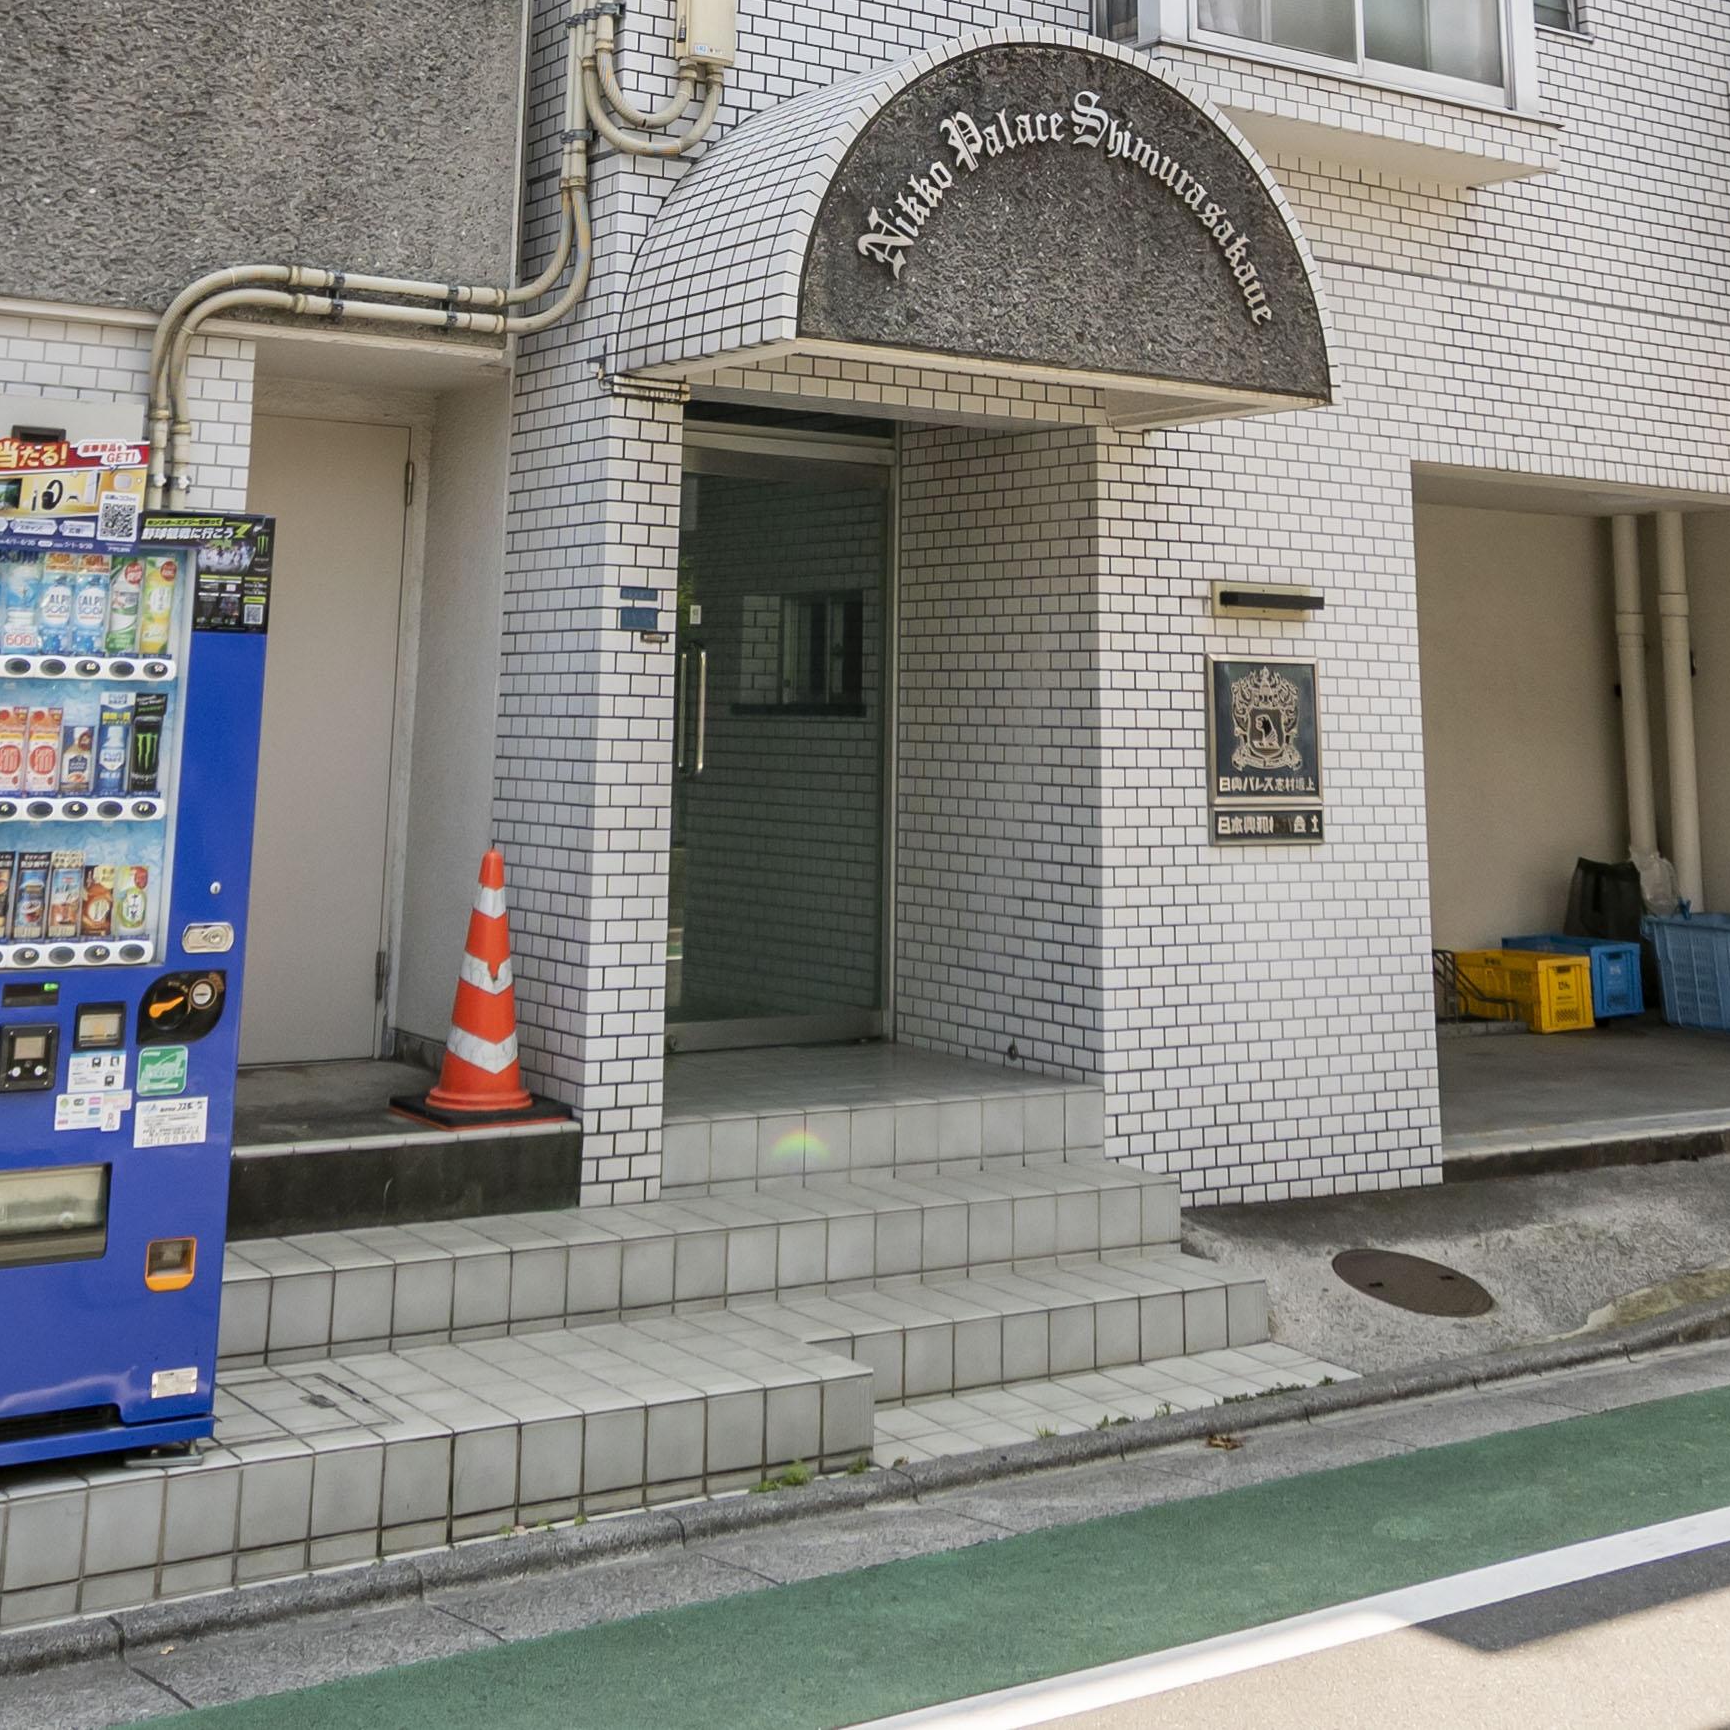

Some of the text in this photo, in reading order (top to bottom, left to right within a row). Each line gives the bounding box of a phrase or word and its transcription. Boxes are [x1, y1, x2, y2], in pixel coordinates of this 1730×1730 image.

[858, 90, 1273, 326] Nikko Palace Shimurasakaue
